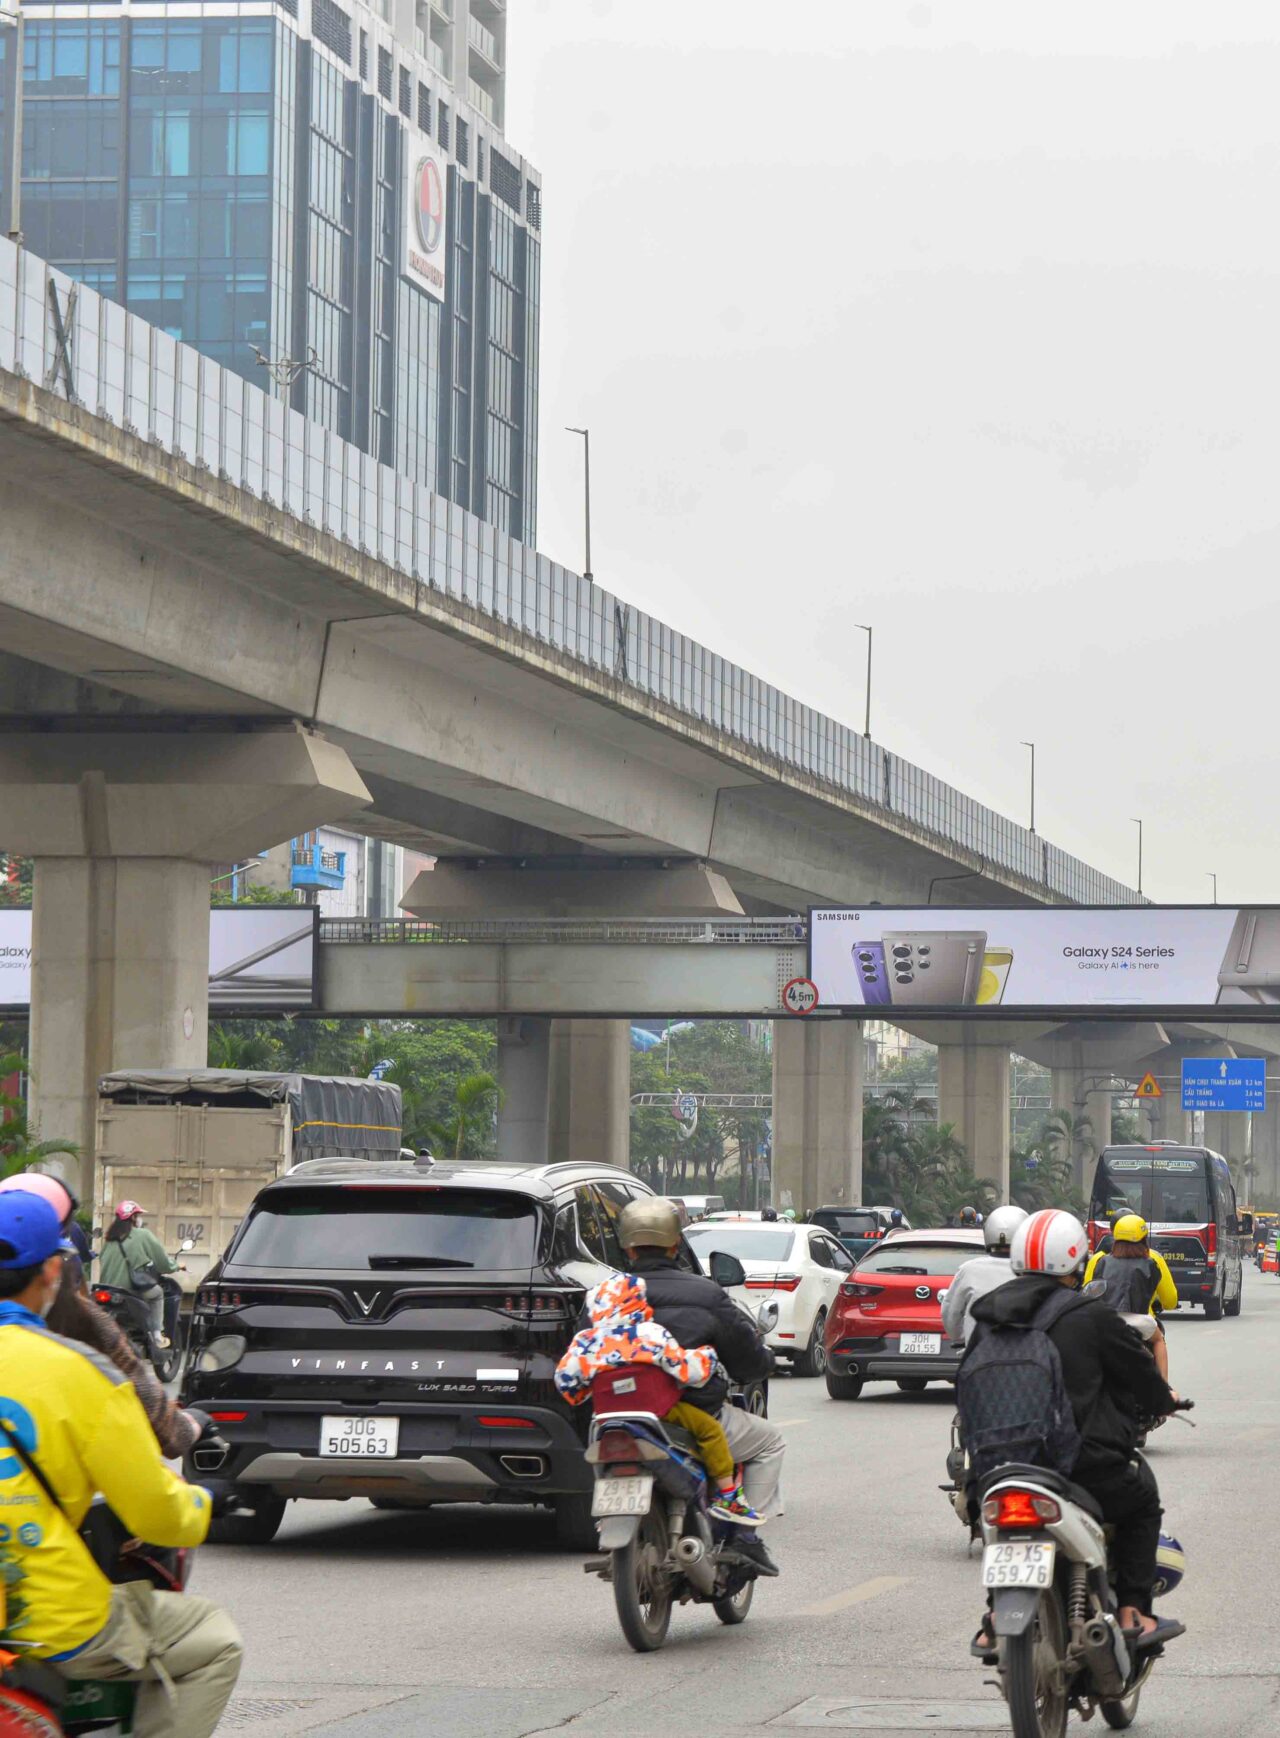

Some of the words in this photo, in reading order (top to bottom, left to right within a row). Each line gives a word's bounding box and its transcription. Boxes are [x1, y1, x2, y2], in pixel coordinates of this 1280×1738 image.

[817, 913, 860, 921] SAMSUNG
[0, 946, 31, 959] alaxy
[1063, 946, 1109, 959] Galaxy
[1111, 946, 1133, 957] S24
[1135, 946, 1175, 957] Series
[1078, 961, 1109, 971] Galaxy
[1110, 961, 1119, 970] AI
[1129, 961, 1137, 970] is
[1138, 961, 1160, 970] here
[911, 1334, 929, 1343] 30H
[904, 1344, 936, 1353] 201.55
[291, 1358, 445, 1370] VINFAST
[343, 1419, 376, 1435] 30G
[329, 1437, 388, 1454] 505.63
[994, 1544, 1044, 1563] 29-X5
[986, 1565, 1047, 1584] 659.76
